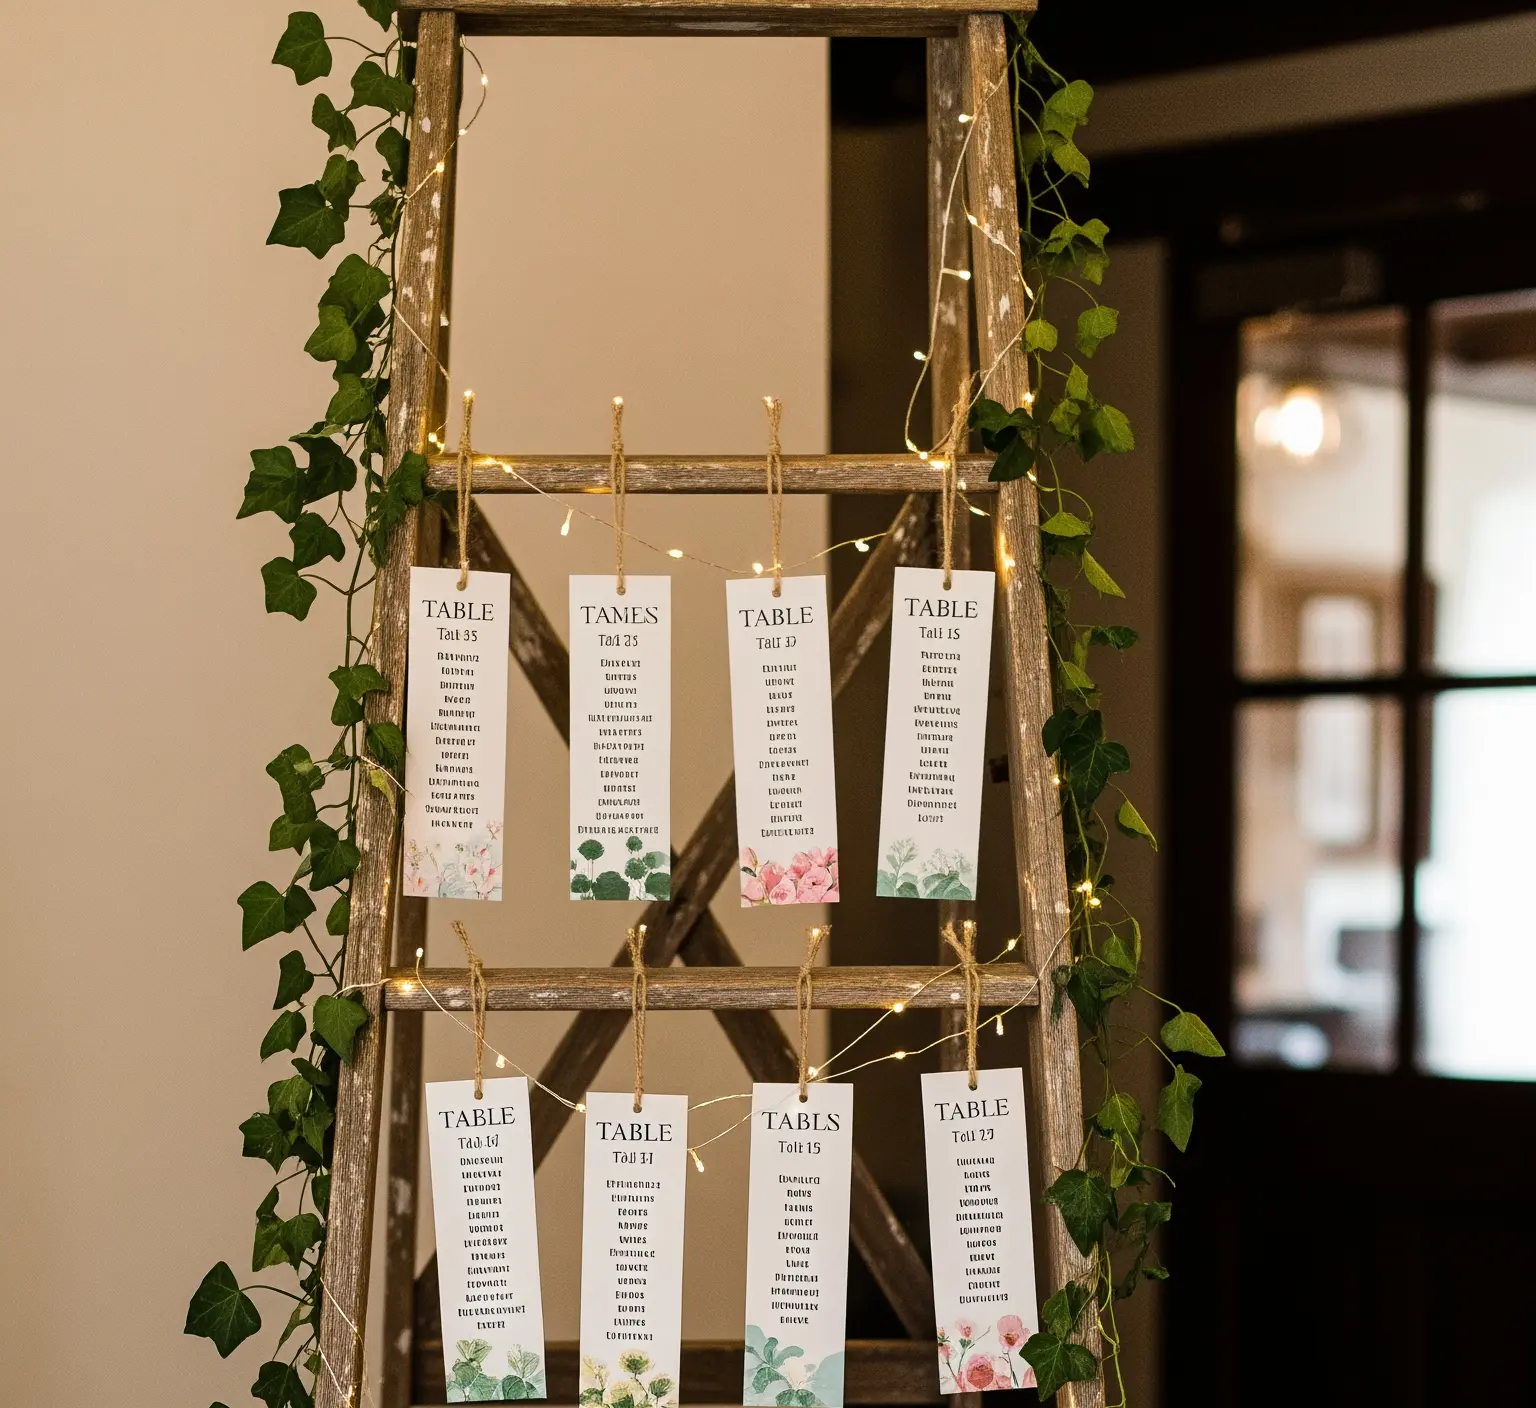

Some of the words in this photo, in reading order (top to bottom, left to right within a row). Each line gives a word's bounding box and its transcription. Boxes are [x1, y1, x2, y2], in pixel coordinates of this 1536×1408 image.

[422, 600, 494, 621] TABLE
[739, 606, 813, 627] TABLE
[904, 598, 978, 618] TABLE
[439, 1107, 515, 1128] TABLE
[934, 1099, 1009, 1121] TABLE
[596, 1122, 672, 1141] TABLE
